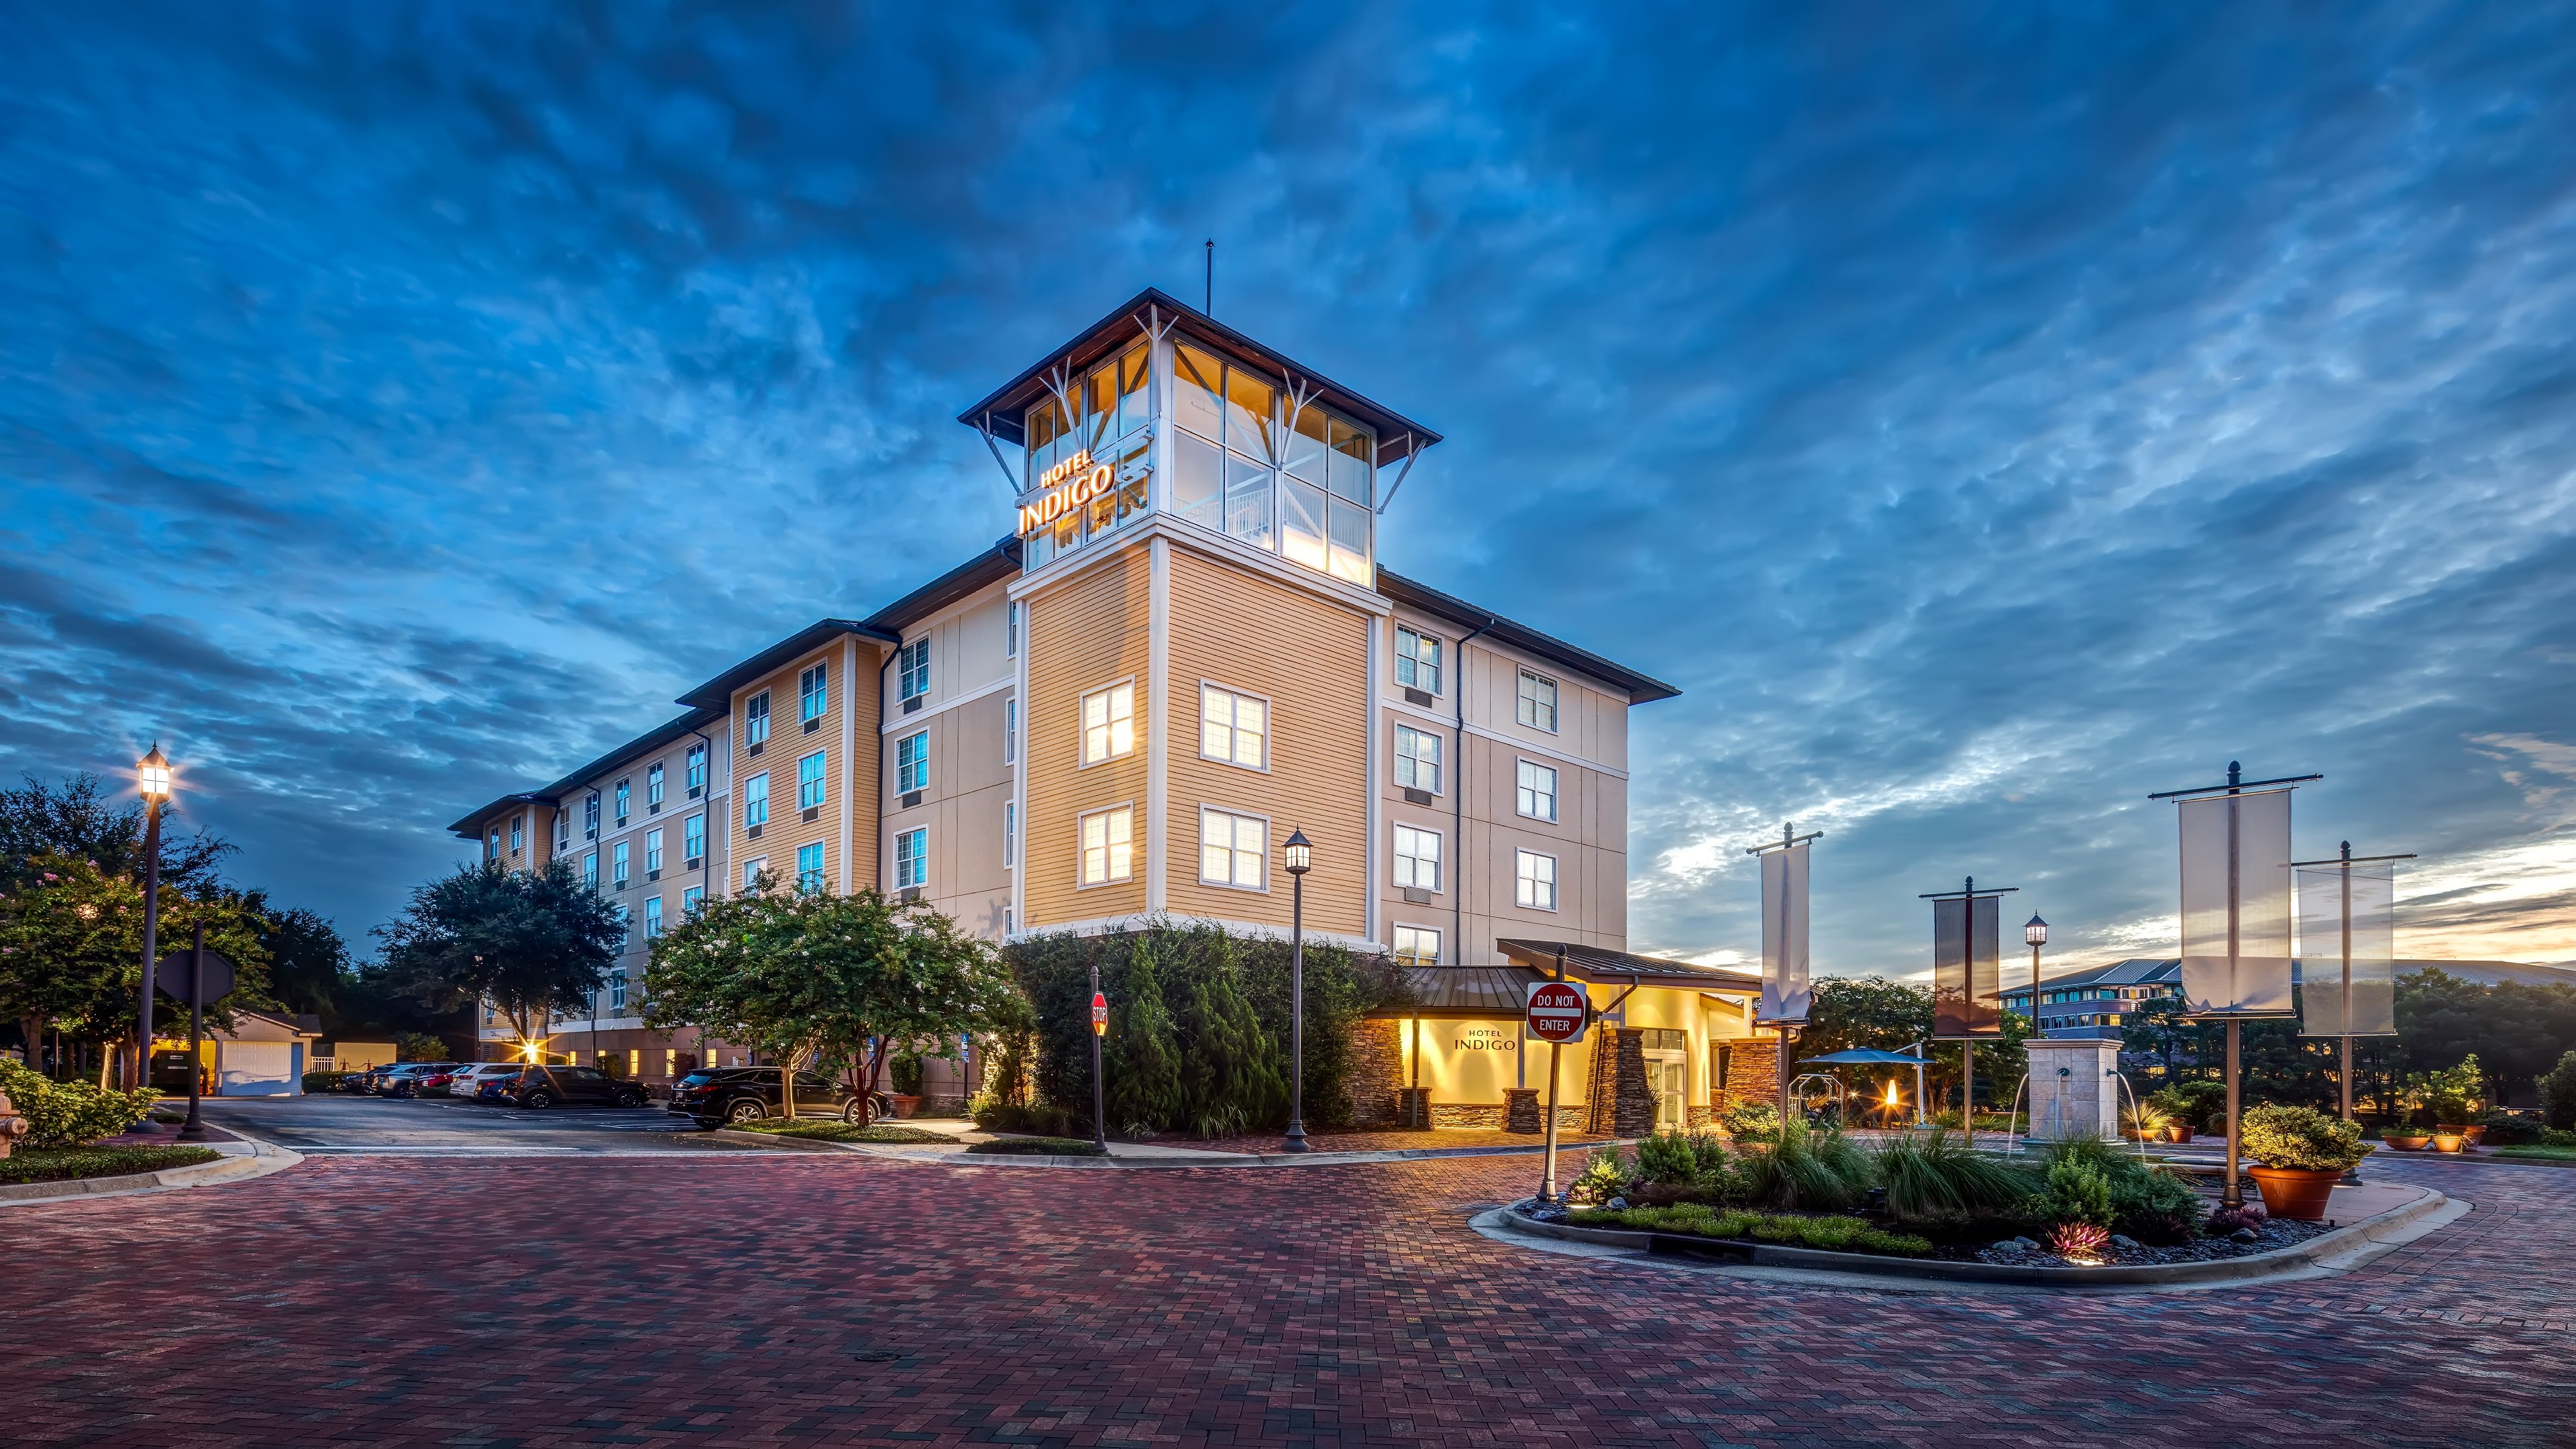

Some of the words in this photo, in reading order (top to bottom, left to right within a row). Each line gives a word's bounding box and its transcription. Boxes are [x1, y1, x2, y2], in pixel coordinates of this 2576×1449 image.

[1041, 449, 1093, 489] HOTEL
[1020, 466, 1115, 535] INDIGO
[1538, 995, 1552, 1006] DO
[1556, 995, 1574, 1007] NOT
[1093, 1006, 1106, 1022] STOP
[1540, 1019, 1570, 1031] ENTER
[1454, 1039, 1515, 1051] INDIGO
